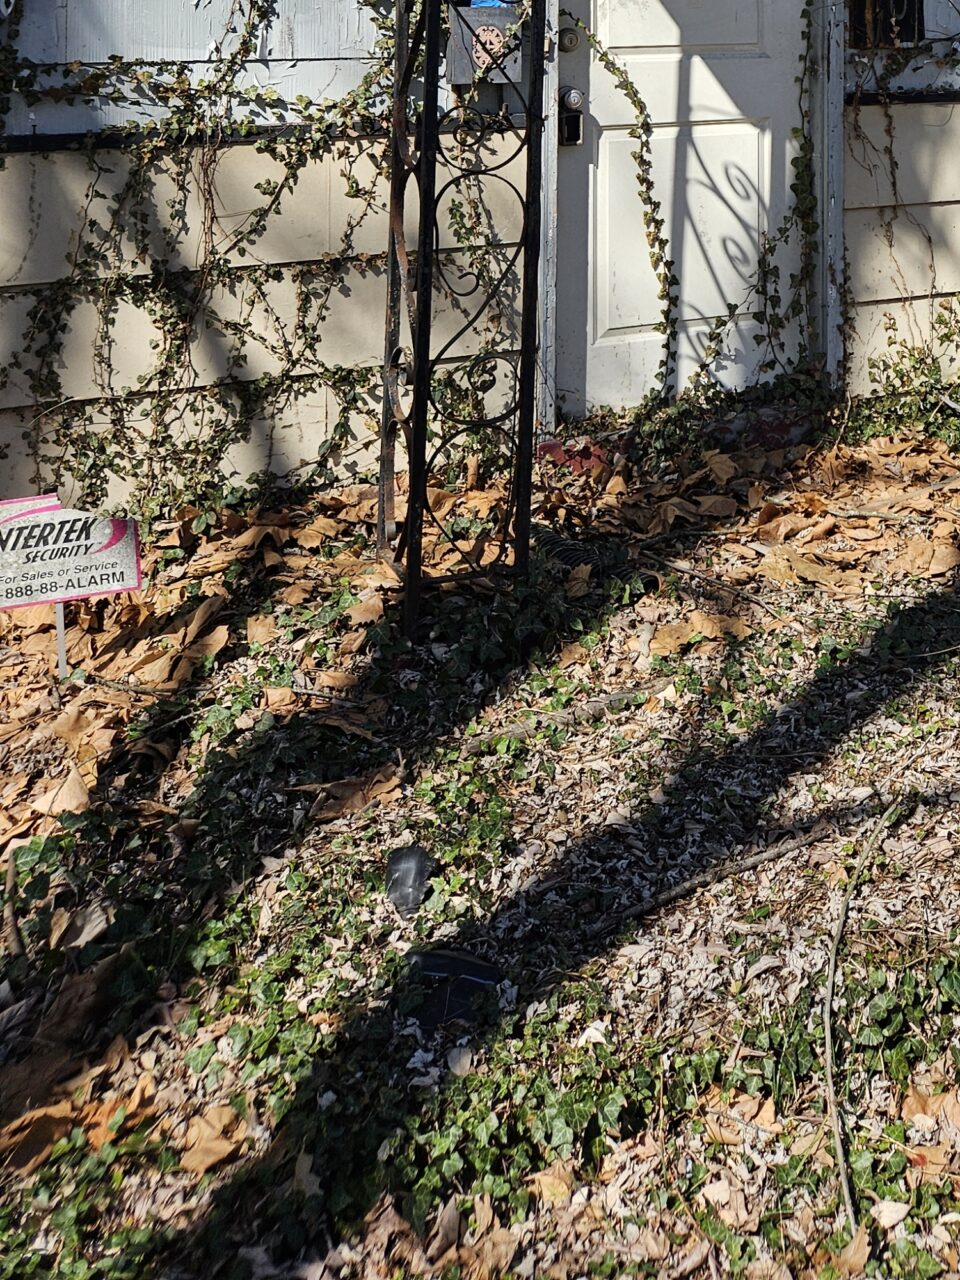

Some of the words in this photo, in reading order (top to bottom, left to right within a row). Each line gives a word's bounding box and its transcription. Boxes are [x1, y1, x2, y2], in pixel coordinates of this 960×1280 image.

[0, 516, 98, 552] NTERTEK
[22, 543, 94, 564] SECURITY
[21, 570, 54, 582] Sales
[57, 568, 71, 577] or
[74, 561, 118, 574] Service
